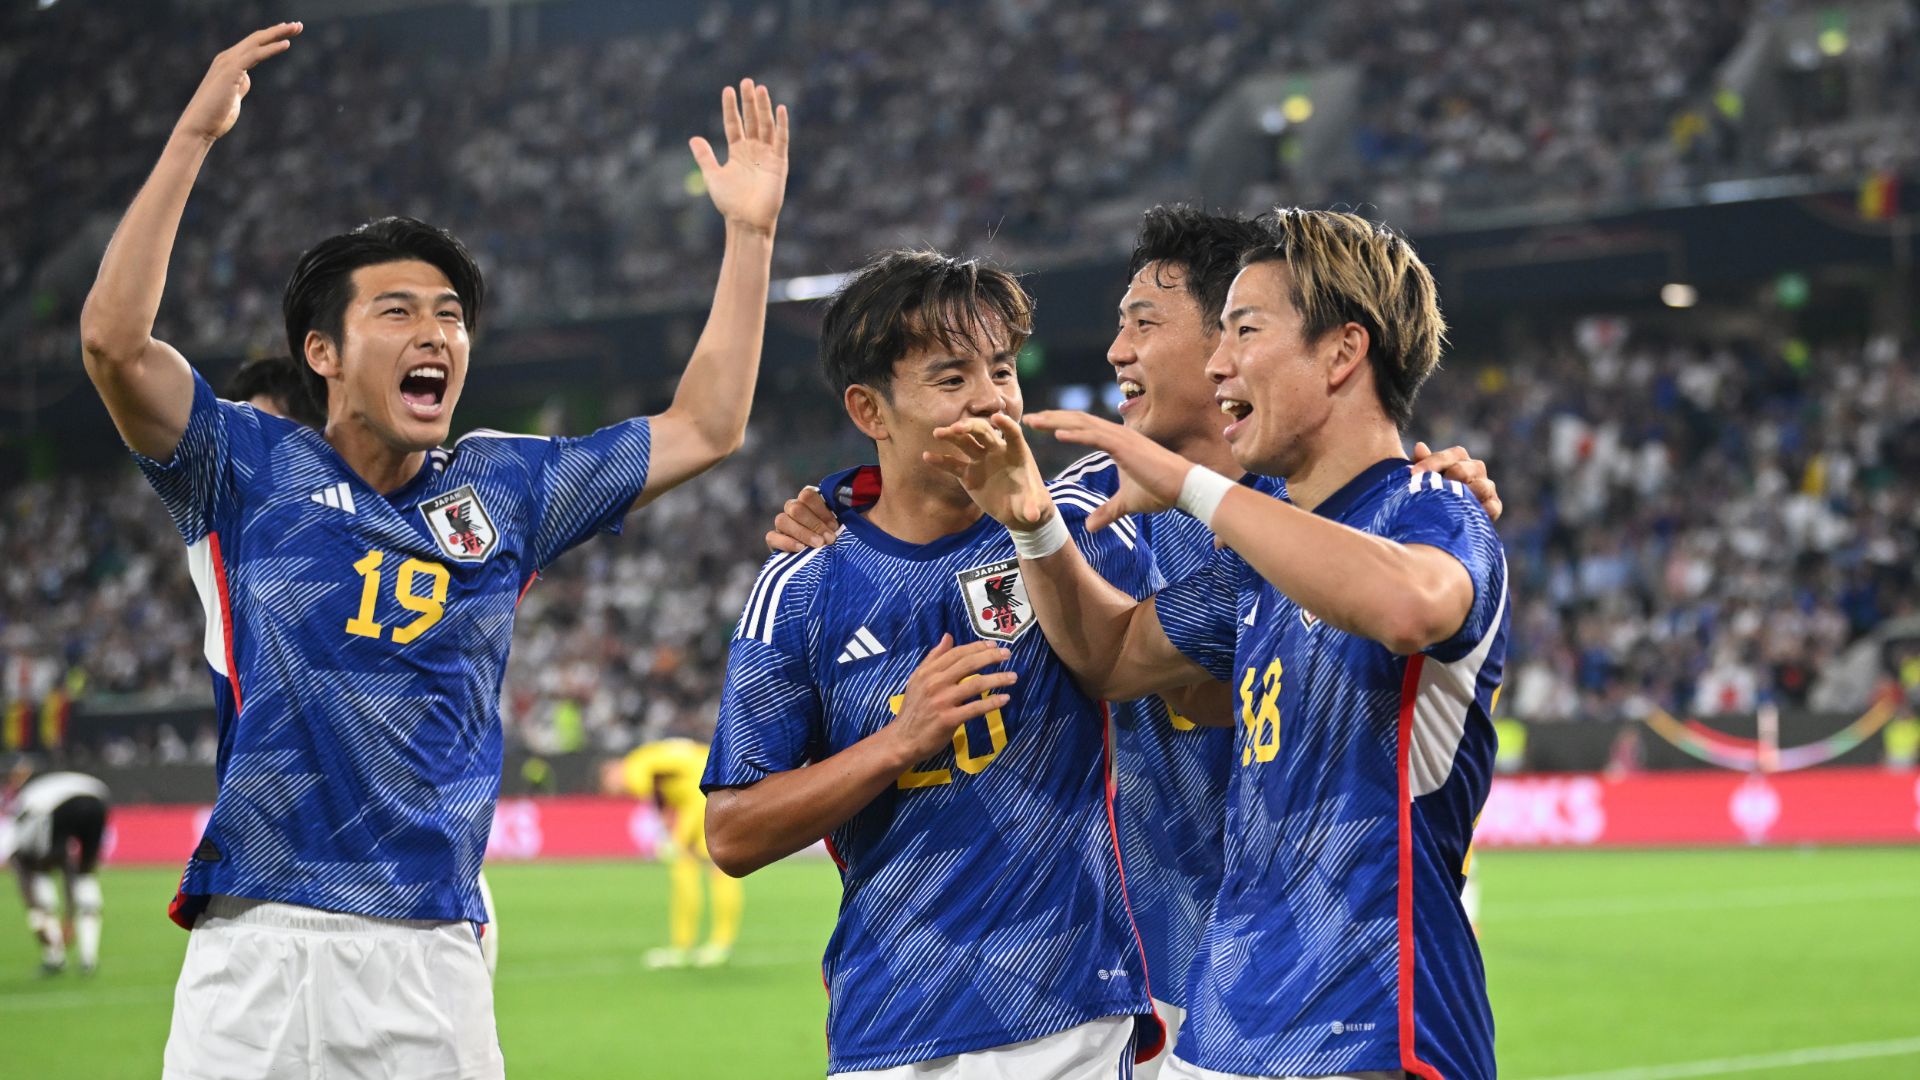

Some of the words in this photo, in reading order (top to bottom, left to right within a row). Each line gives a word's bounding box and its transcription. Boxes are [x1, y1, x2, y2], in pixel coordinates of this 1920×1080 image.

[434, 491, 461, 508] JAPAN
[460, 536, 485, 553] JFA
[974, 563, 1008, 577] JAPAN
[345, 549, 450, 645] 19
[993, 613, 1021, 631] JFA
[1239, 657, 1283, 767] 18
